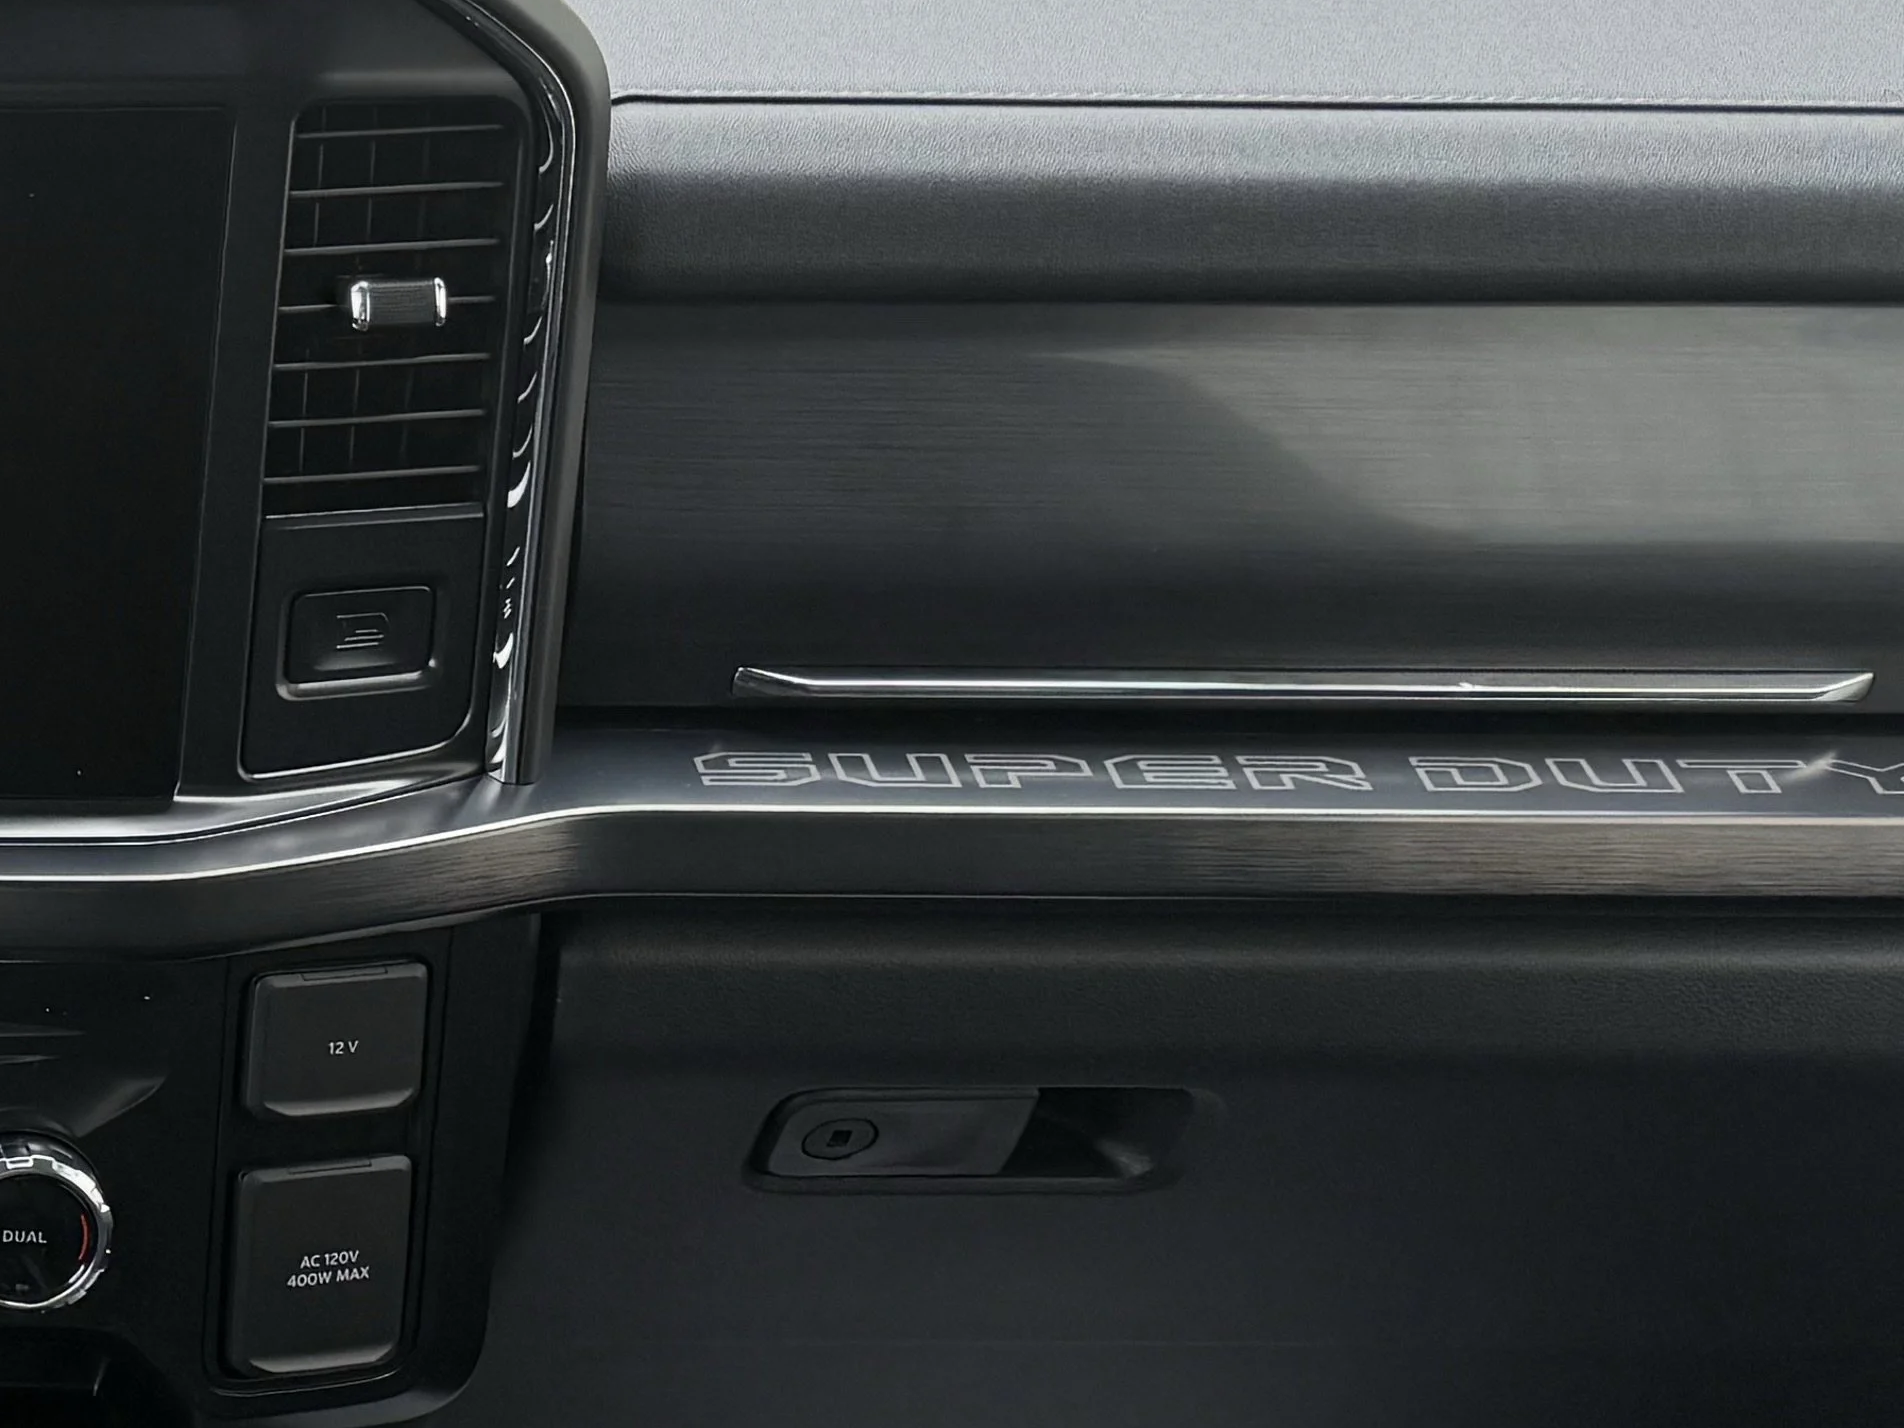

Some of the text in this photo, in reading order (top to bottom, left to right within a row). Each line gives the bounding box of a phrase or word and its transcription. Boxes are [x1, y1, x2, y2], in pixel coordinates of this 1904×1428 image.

[693, 752, 1373, 792] SUPER
[328, 1040, 359, 1055] 12 V
[2, 1229, 48, 1244] DUAL
[300, 1250, 360, 1269] AC 120V
[286, 1266, 370, 1289] 400W MAX
